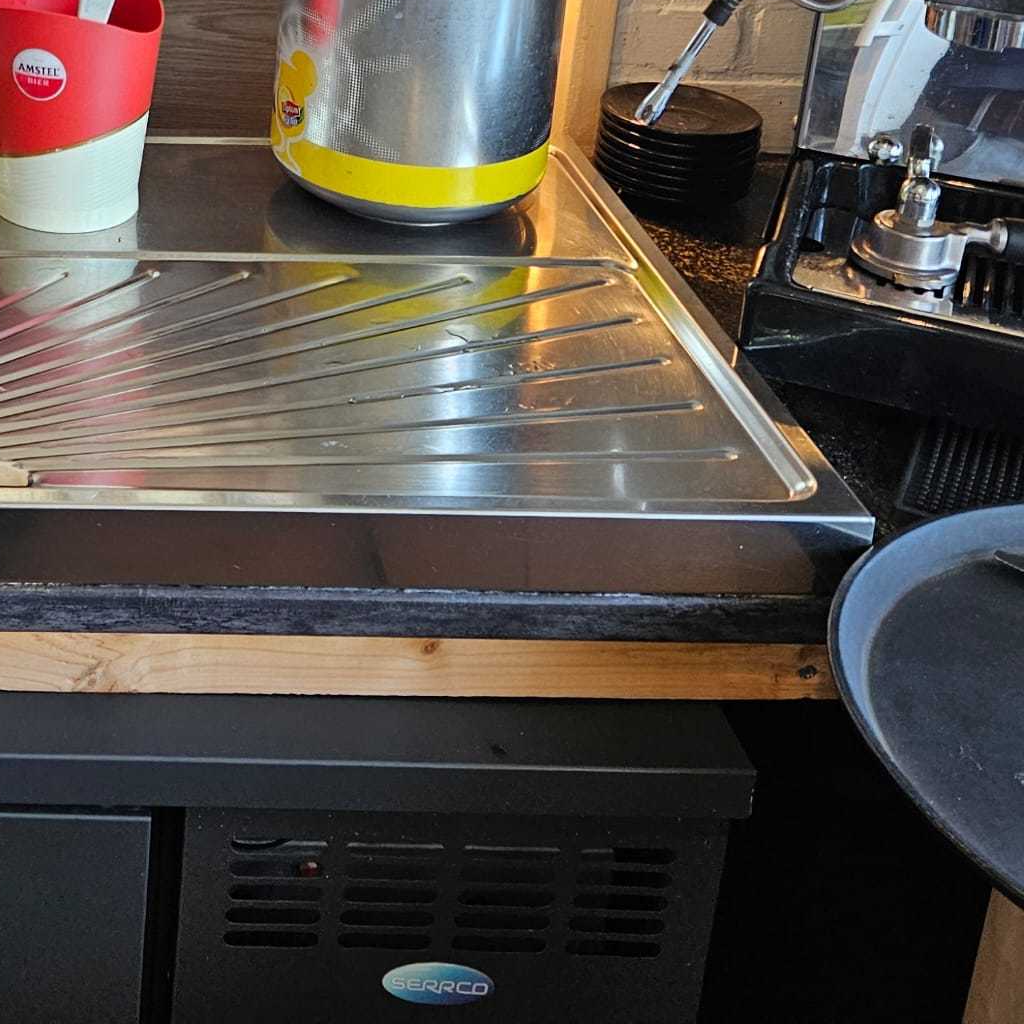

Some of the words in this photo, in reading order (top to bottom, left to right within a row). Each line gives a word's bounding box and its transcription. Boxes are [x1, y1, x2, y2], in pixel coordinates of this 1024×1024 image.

[18, 62, 59, 77] AMSTEL
[27, 77, 49, 86] BIER
[392, 977, 489, 996] SERRCO
